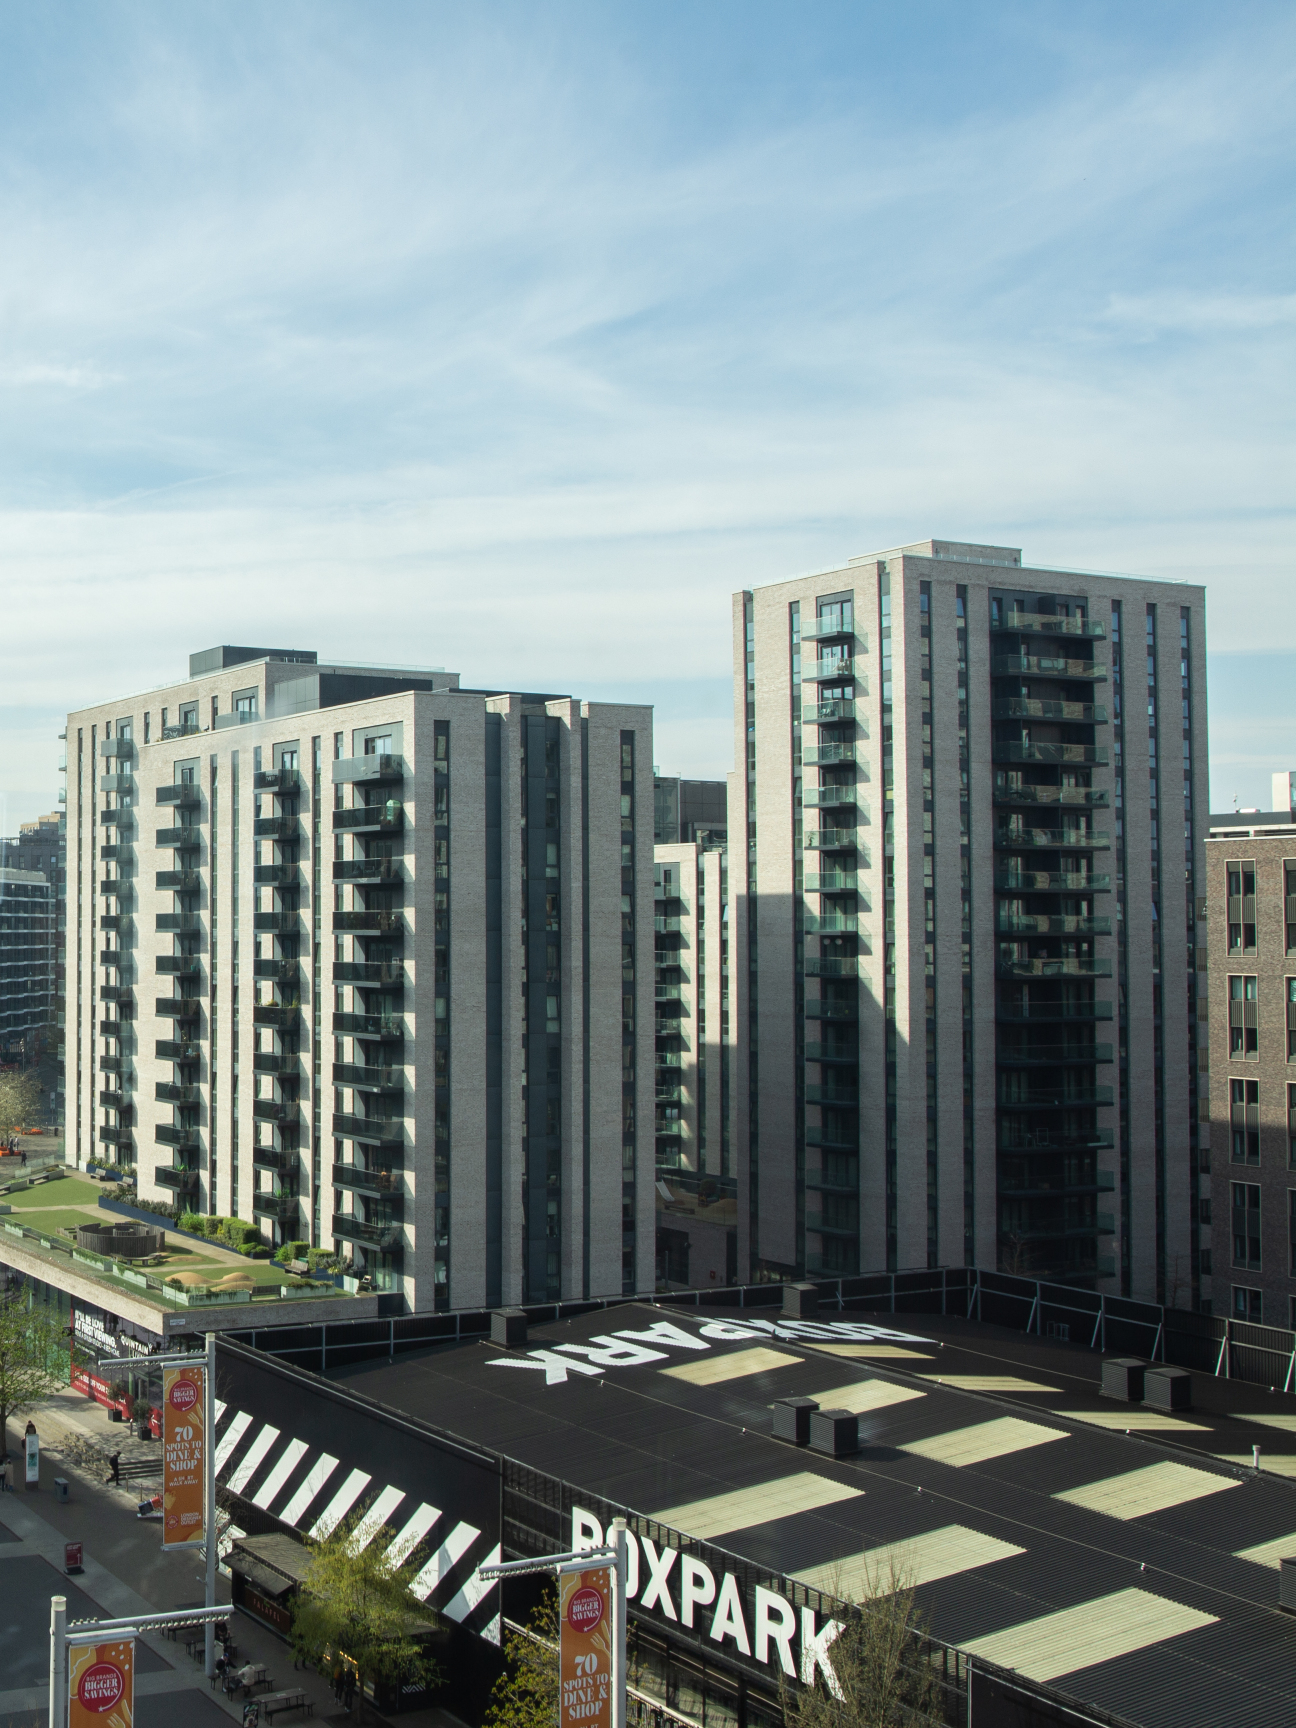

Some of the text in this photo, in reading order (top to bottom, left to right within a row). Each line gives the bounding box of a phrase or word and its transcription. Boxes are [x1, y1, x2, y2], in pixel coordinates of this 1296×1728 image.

[75, 1319, 81, 1330] AT
[82, 1321, 93, 1337] FIRST
[92, 1318, 104, 1332] LOVE
[121, 1335, 148, 1355] QUINTAIN
[485, 1317, 937, 1385] BOXPARK
[174, 1390, 194, 1398] BIGGER
[174, 1426, 193, 1442] 70
[166, 1440, 201, 1451] SPOTS TO
[166, 1449, 201, 1462] DINE &
[170, 1460, 197, 1472] SHOP
[254, 1598, 280, 1622] FALAFEL
[572, 1506, 847, 1703] BOXPARK
[573, 1602, 599, 1613] BIGGER
[573, 1610, 599, 1621] SAVINGS
[575, 1653, 598, 1676] 70
[85, 1678, 118, 1690] BIGGER
[564, 1673, 608, 1692] SPOTS TO
[84, 1687, 118, 1699] SAVINGS
[564, 1685, 607, 1706] DINE &
[569, 1701, 602, 1720] SHOP
